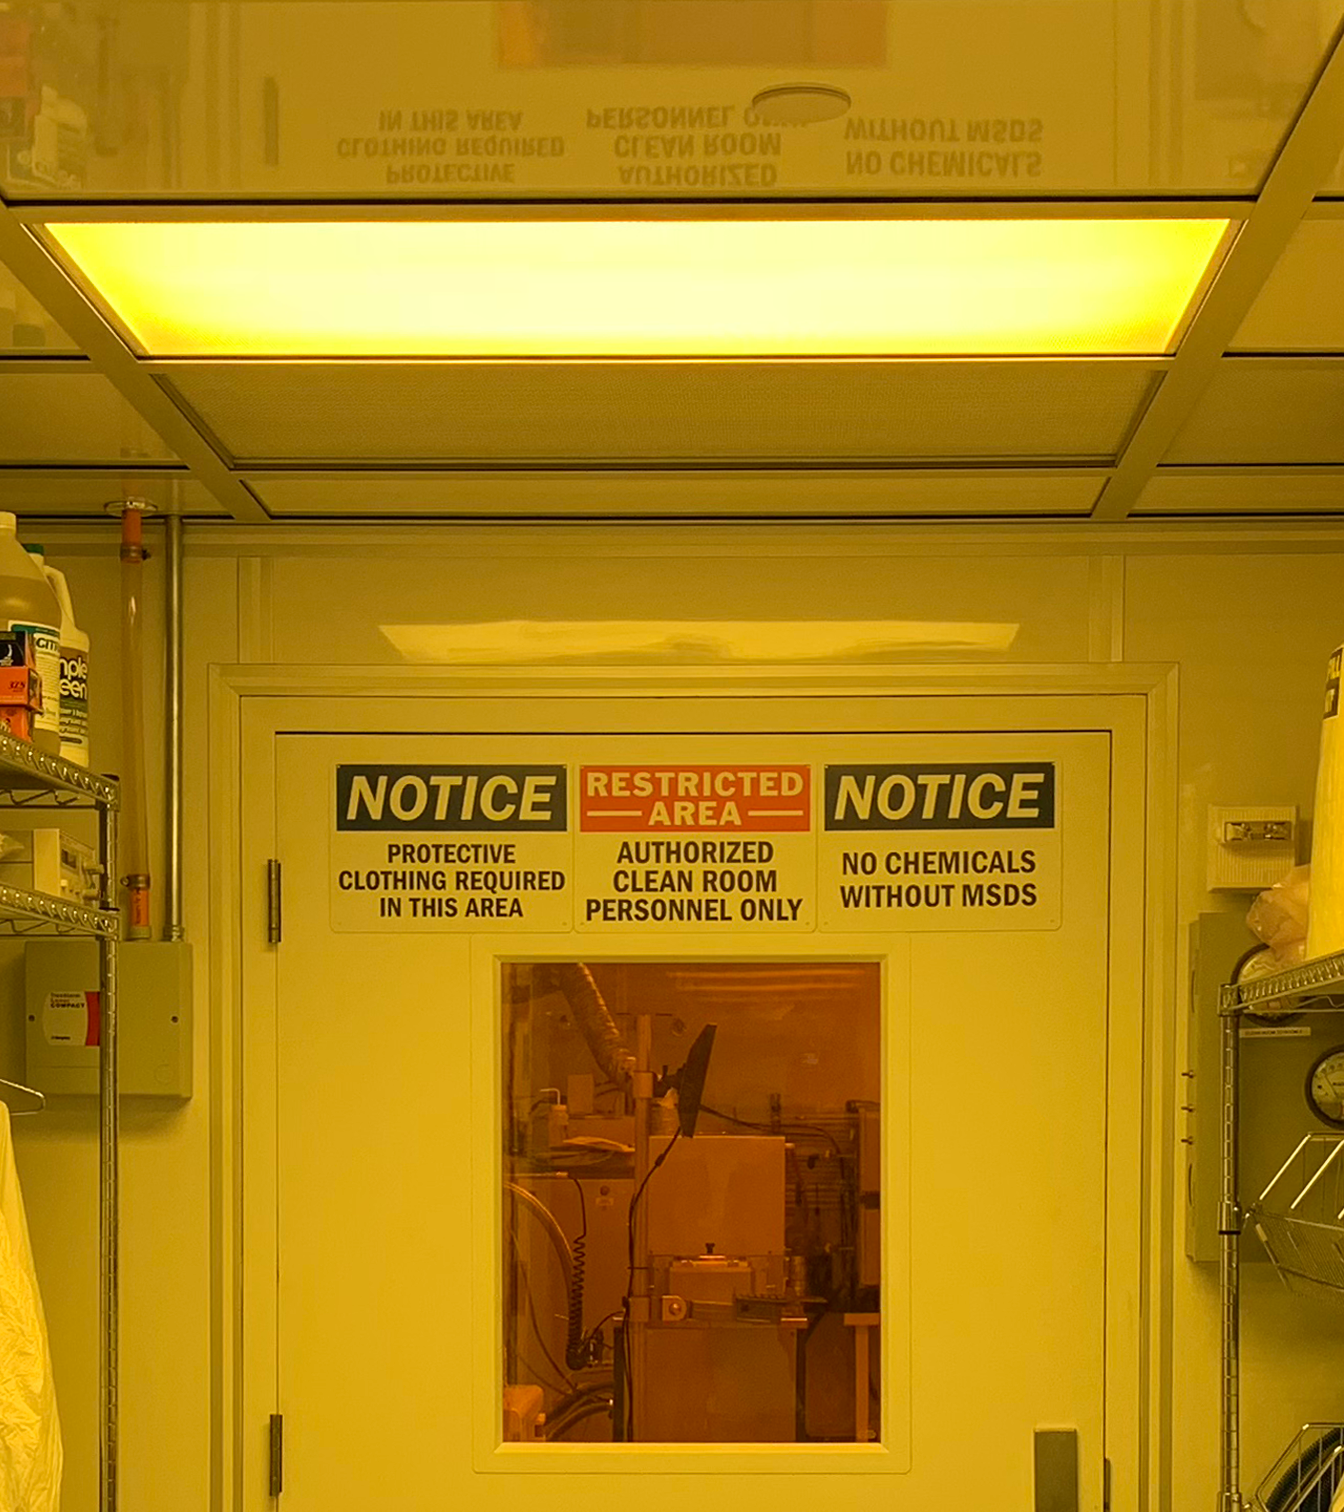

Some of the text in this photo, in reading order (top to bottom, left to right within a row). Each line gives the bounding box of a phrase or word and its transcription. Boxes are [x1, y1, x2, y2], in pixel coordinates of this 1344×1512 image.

[60, 657, 87, 681] mple
[60, 679, 87, 699] een
[586, 771, 804, 799] RESTRICTED
[833, 771, 1044, 821] NOTICE
[346, 774, 557, 822] NOTICE
[647, 802, 742, 826] AREA
[387, 843, 516, 865] PROTECTIVE
[616, 841, 775, 865] AUTHORIZED
[841, 849, 1037, 876] NO CHEMICALS
[338, 869, 567, 893] CLOTHING REQUIRED
[612, 870, 778, 893] CLEAN ROOM
[839, 882, 1037, 909] WITHOUT MSDS
[379, 897, 524, 919] IN THIS AREA
[585, 899, 804, 923] PERSONNEL ONLY
